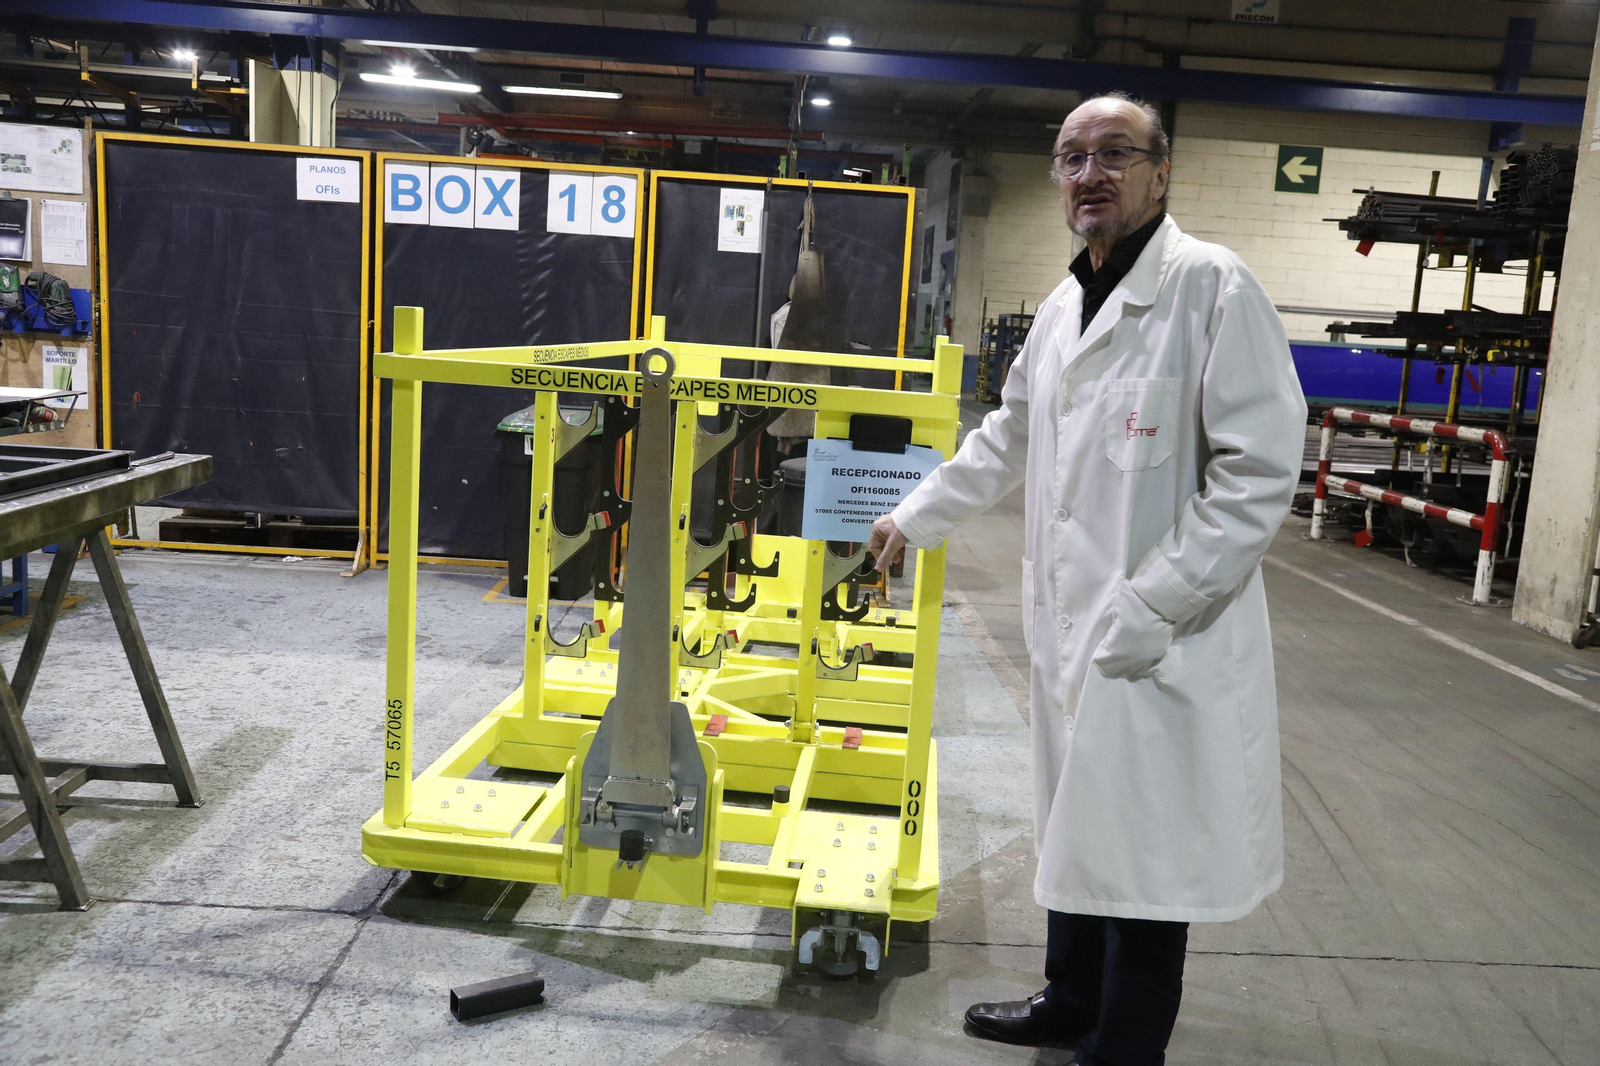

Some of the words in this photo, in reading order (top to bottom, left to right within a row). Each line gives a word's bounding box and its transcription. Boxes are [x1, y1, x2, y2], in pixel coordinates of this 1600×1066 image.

[1235, 14, 1275, 22] PRECON
[308, 165, 347, 175] PLANOS
[315, 184, 341, 195] OFIs
[390, 172, 515, 217] BOX
[557, 183, 627, 224] 18
[45, 357, 78, 365] MARTILLO
[511, 368, 629, 392] SECUENCIA
[736, 383, 818, 406] MEDIOS
[831, 467, 922, 480] RECEPCIONADO
[850, 486, 901, 496] OFI160085
[837, 499, 869, 507] MERCEDES
[833, 509, 873, 517] CONTENEDOR
[386, 699, 403, 751] 57065
[385, 761, 401, 782] T5
